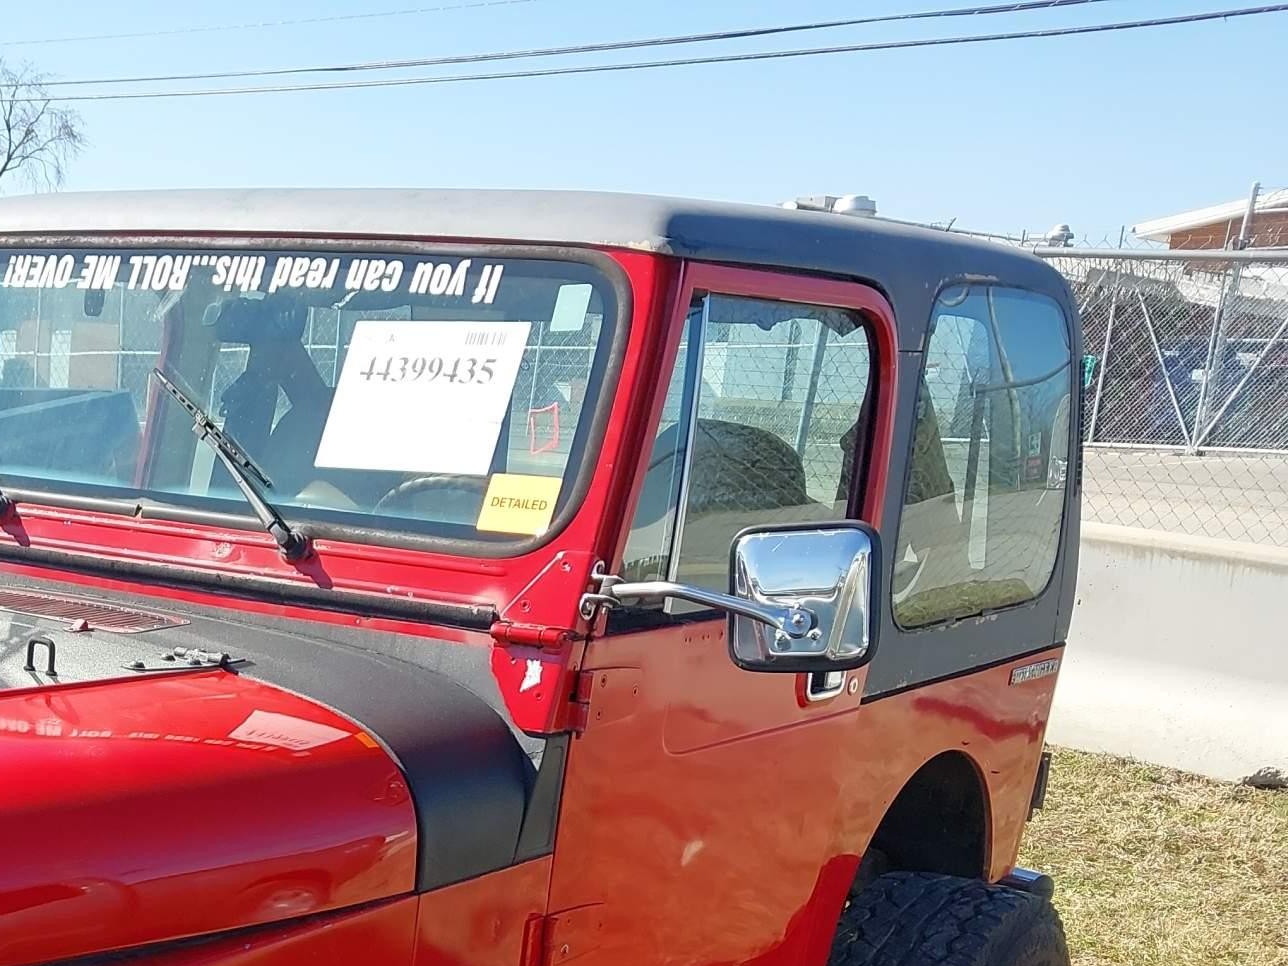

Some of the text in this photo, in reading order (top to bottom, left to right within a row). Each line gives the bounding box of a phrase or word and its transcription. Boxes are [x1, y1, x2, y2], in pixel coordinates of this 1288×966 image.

[2, 254, 75, 288] OVER!
[77, 255, 122, 290] ME
[269, 256, 341, 293] read
[345, 258, 404, 292] can
[409, 258, 472, 296] you
[471, 264, 505, 304] If
[359, 356, 497, 385] 44399435
[490, 496, 548, 511] DETAILED
